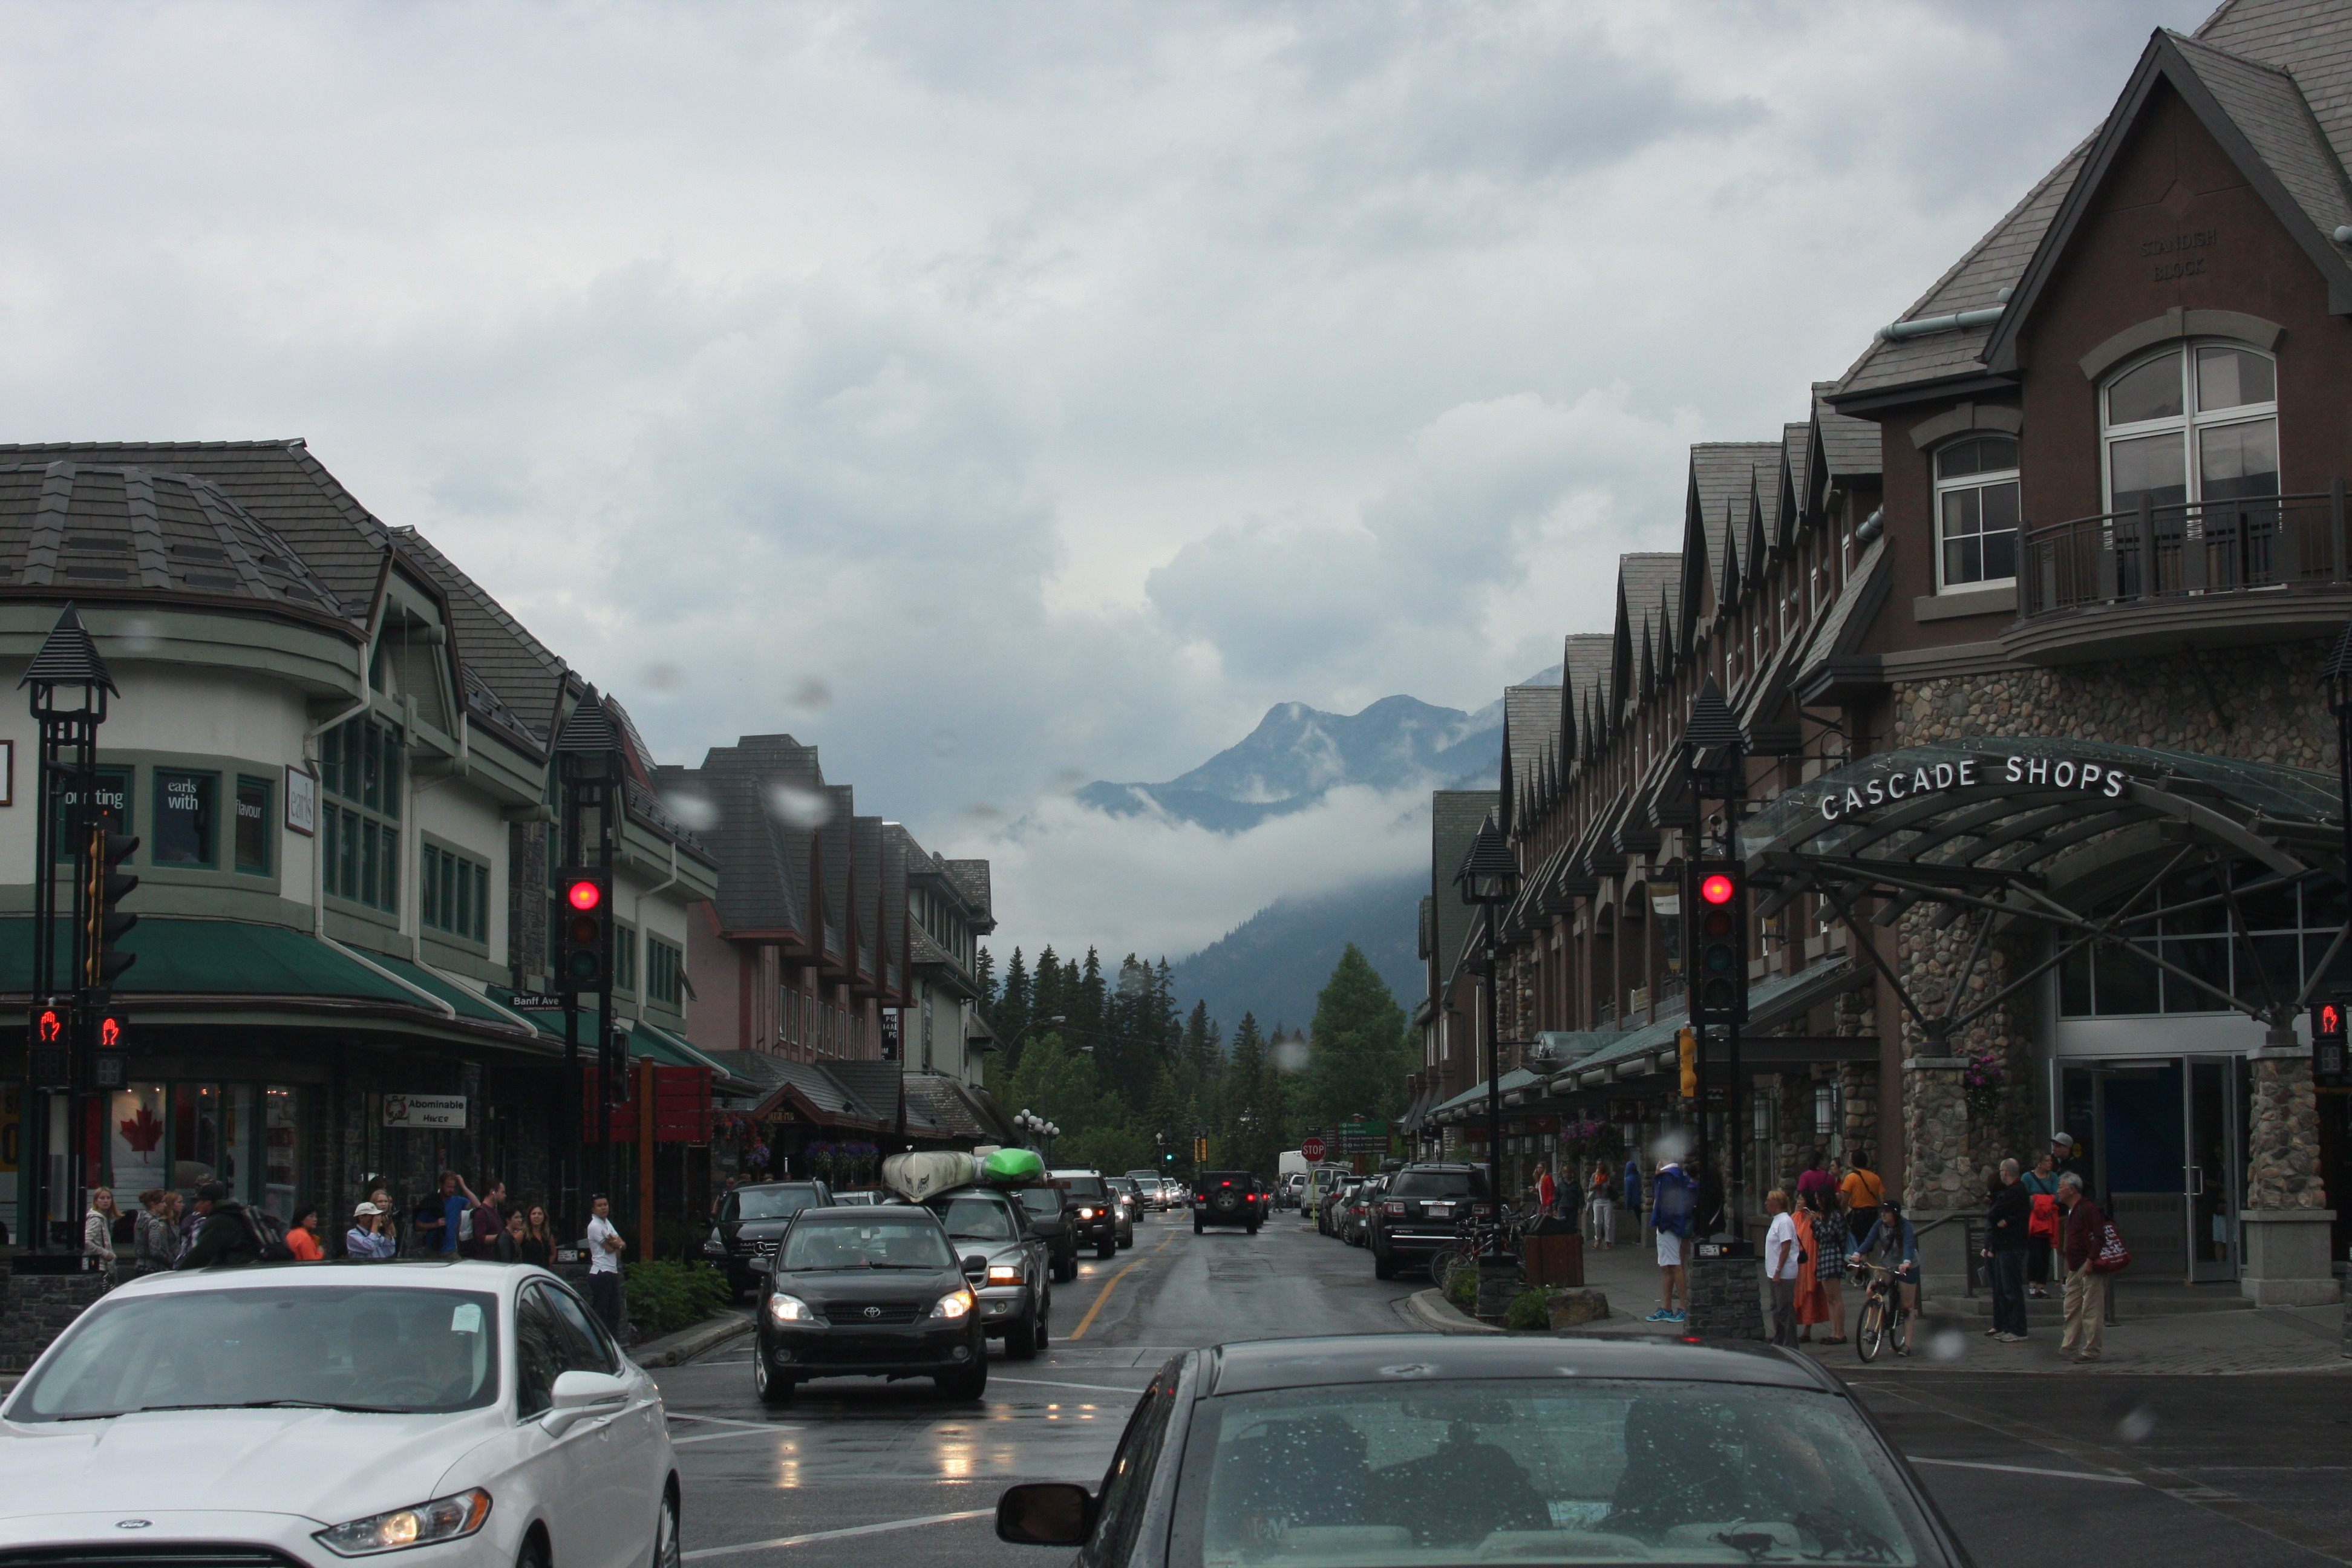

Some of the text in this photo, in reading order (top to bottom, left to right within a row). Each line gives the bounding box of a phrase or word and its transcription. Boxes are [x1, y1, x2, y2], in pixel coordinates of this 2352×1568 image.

[2141, 229, 2217, 257] STANDISH
[2154, 258, 2205, 282] BLOCK
[168, 779, 197, 793] earls
[1821, 756, 2125, 821] CASCADE SHOPS
[168, 793, 198, 811] with
[236, 799, 261, 818] flavour
[290, 782, 312, 824] earls
[514, 996, 539, 1005] Banff
[408, 1100, 464, 1109] Abominable
[423, 1114, 449, 1123] HIKER
[1302, 1145, 1324, 1155] STOP
